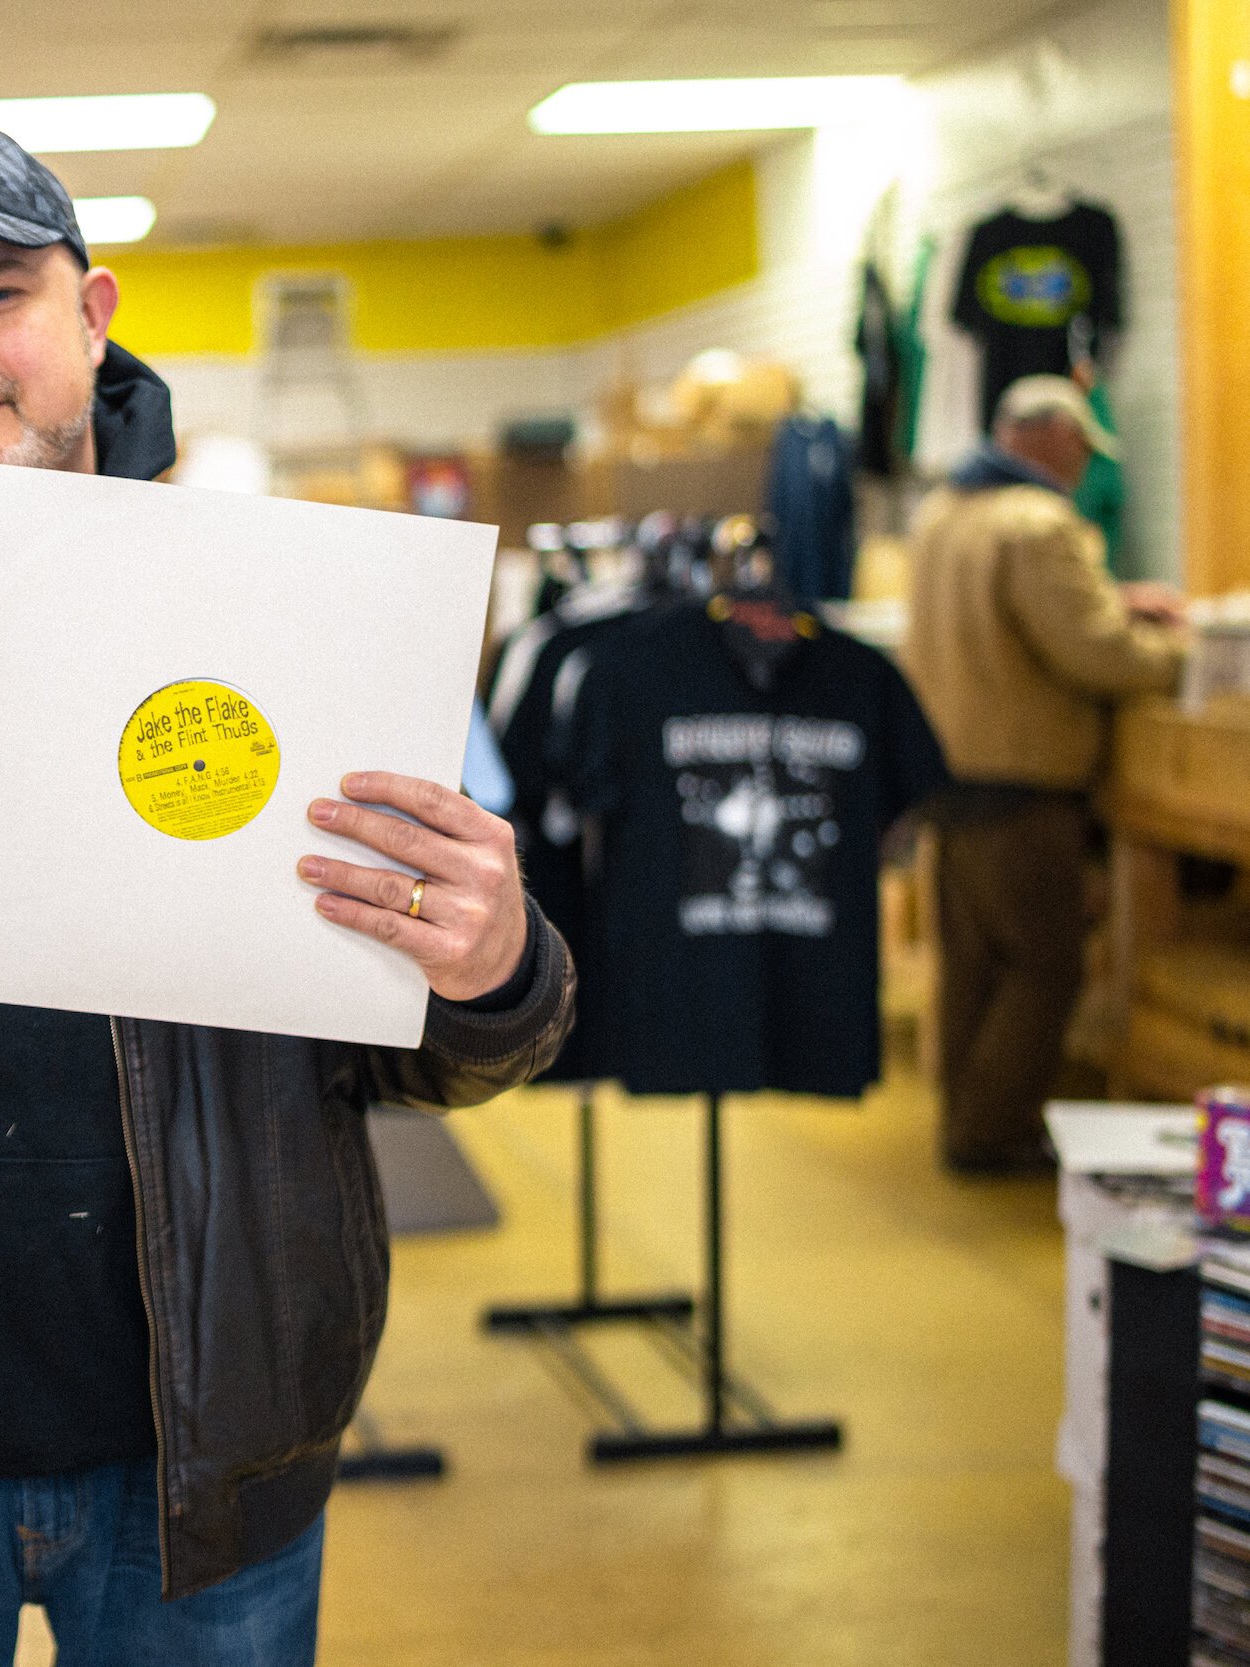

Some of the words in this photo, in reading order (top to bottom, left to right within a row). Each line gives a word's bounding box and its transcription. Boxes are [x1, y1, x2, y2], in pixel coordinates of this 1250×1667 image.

[136, 711, 172, 743] Jake
[174, 701, 203, 729] the
[205, 694, 249, 722] Flake
[136, 749, 145, 761] &
[150, 740, 173, 758] the
[177, 728, 208, 748] Flint
[212, 720, 258, 740] Thugs
[136, 774, 143, 783] B
[214, 775, 241, 787] Murder
